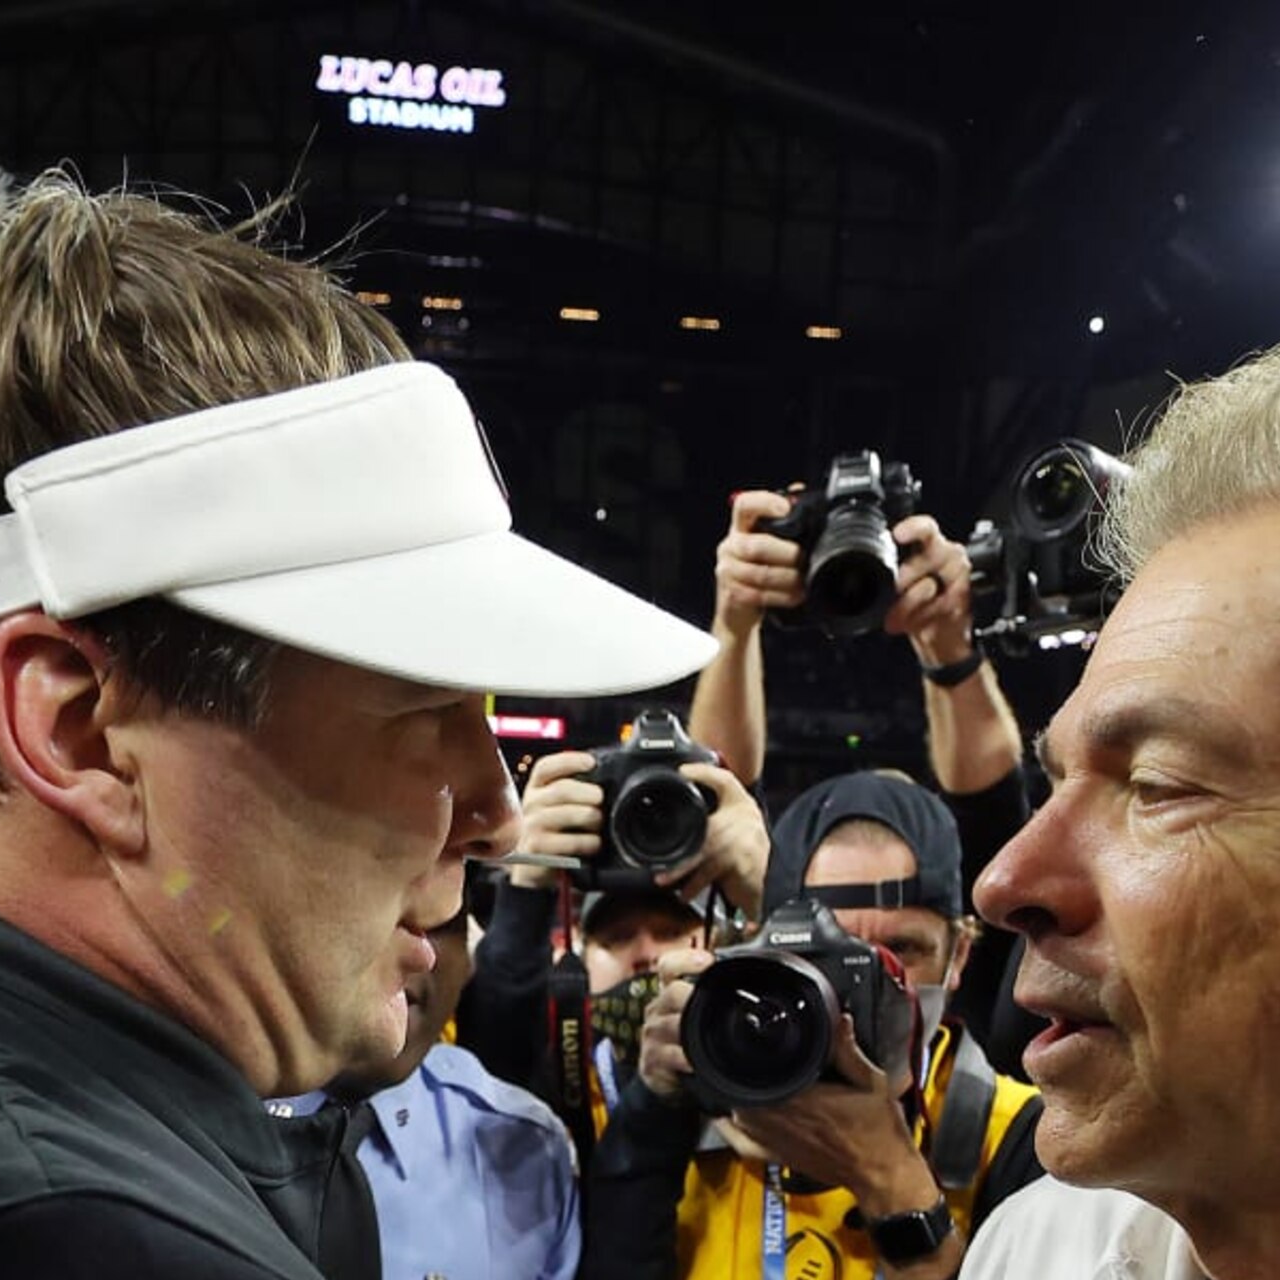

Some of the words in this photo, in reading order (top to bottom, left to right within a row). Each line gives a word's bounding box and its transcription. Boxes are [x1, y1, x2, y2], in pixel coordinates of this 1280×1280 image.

[316, 54, 438, 100] LUCAS
[440, 66, 506, 107] OIL
[348, 96, 474, 133] STADIUM
[769, 932, 812, 944] Canon
